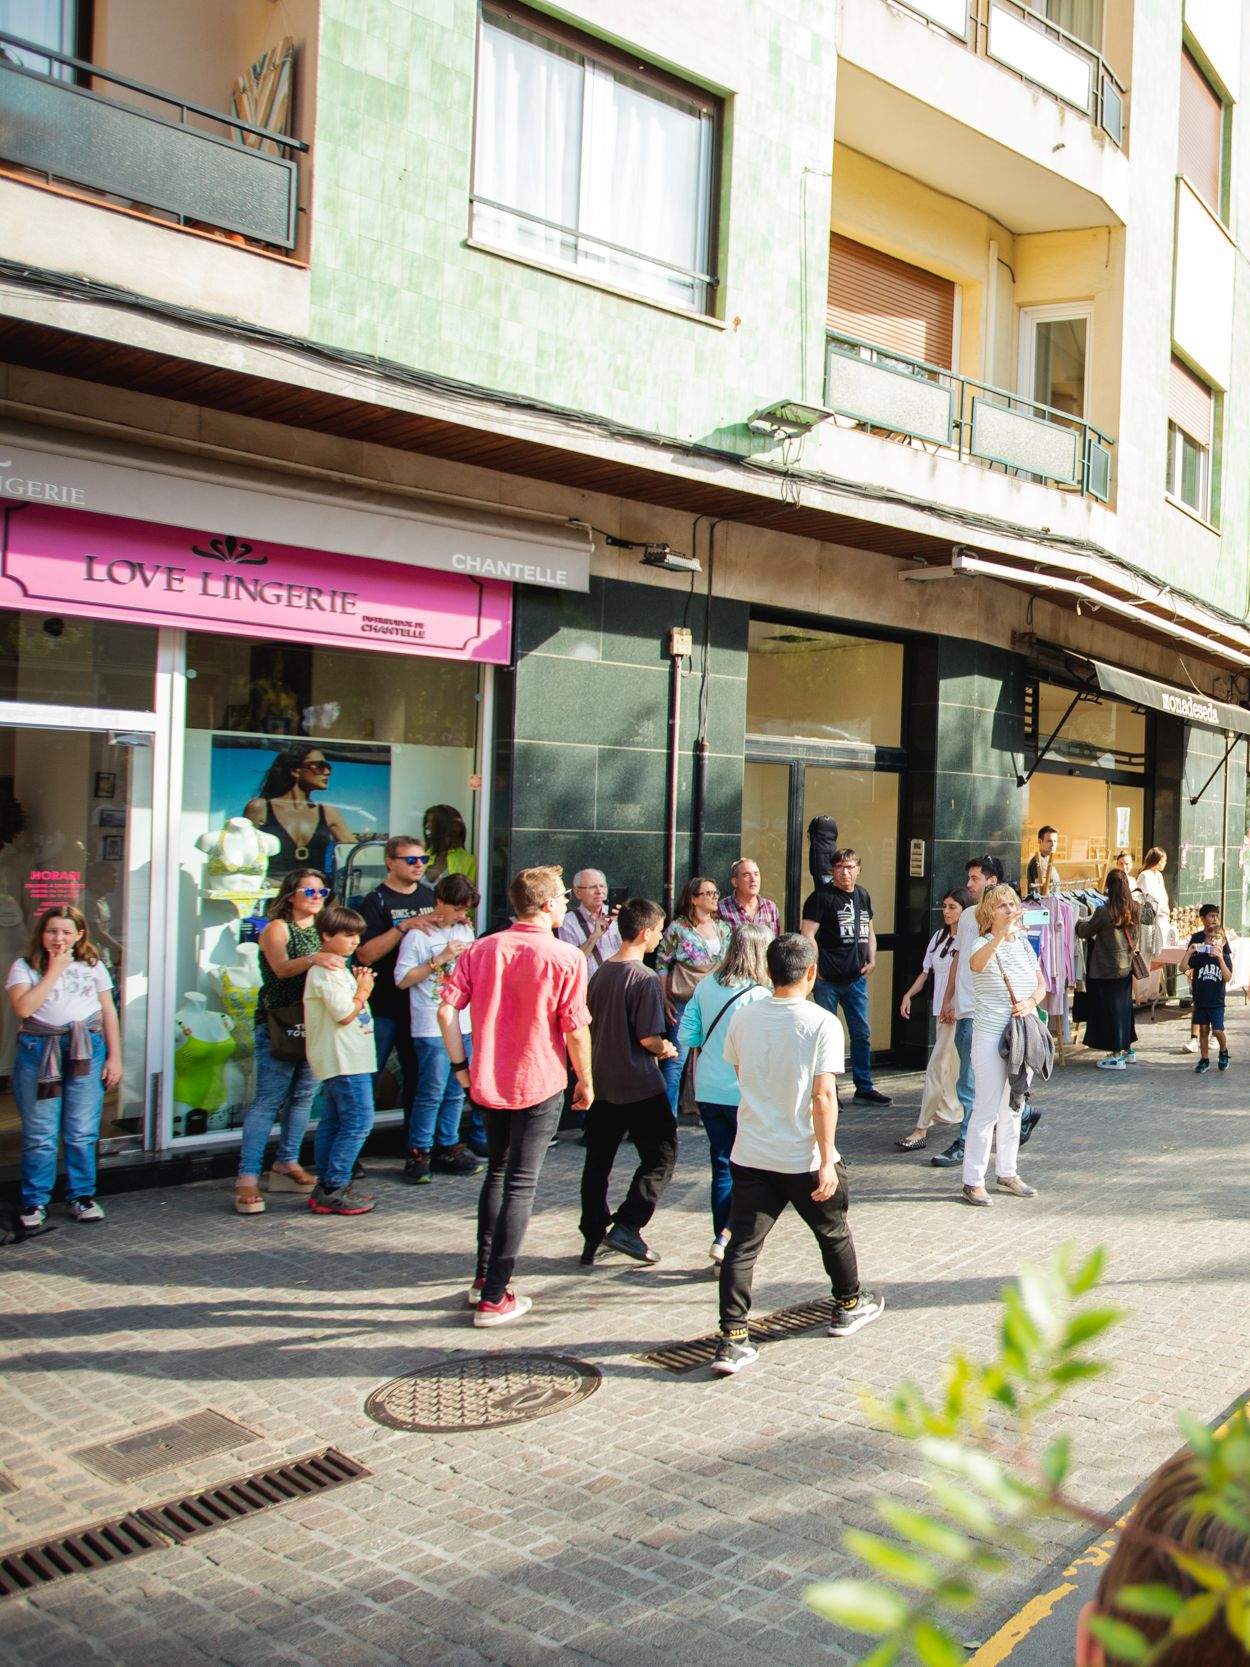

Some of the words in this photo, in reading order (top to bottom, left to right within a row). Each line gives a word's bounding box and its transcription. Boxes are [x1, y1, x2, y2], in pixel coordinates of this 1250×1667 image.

[0, 476, 86, 505] GERIE
[452, 553, 567, 585] CHANTELLE
[83, 554, 186, 593] LOVE
[198, 571, 359, 616] LINGERIE
[361, 623, 426, 639] CHANTELLE
